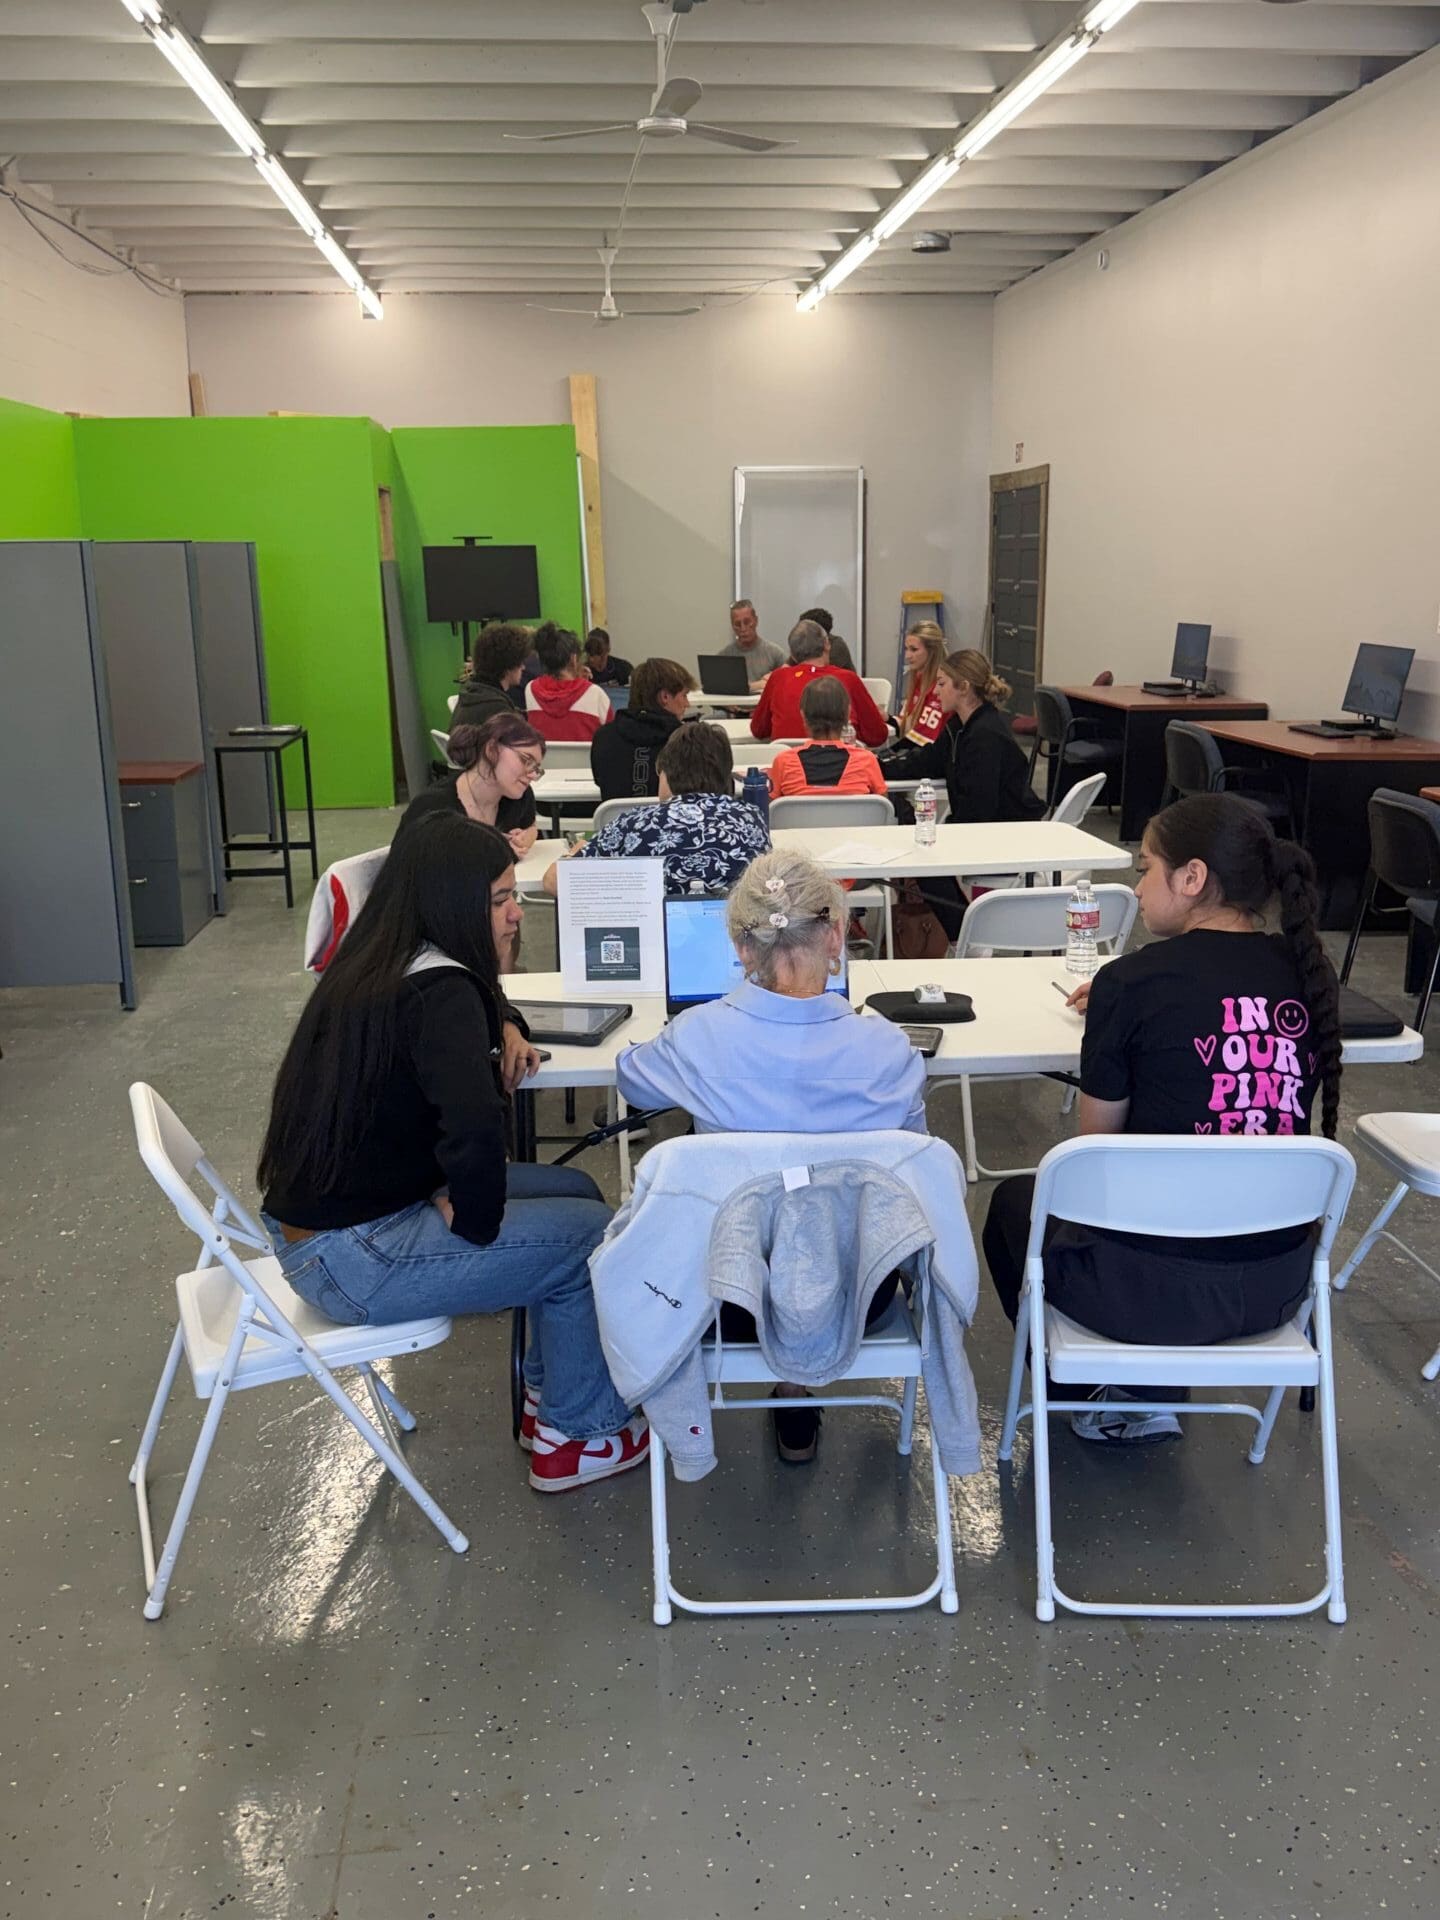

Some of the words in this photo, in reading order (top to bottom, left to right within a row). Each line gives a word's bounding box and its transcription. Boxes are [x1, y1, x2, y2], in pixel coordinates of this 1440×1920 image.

[919, 706, 942, 729] 56
[1221, 996, 1269, 1033] IN
[1222, 1033, 1301, 1076] OUR
[1208, 1071, 1305, 1119] PINK
[1219, 1109, 1294, 1135] ERA
